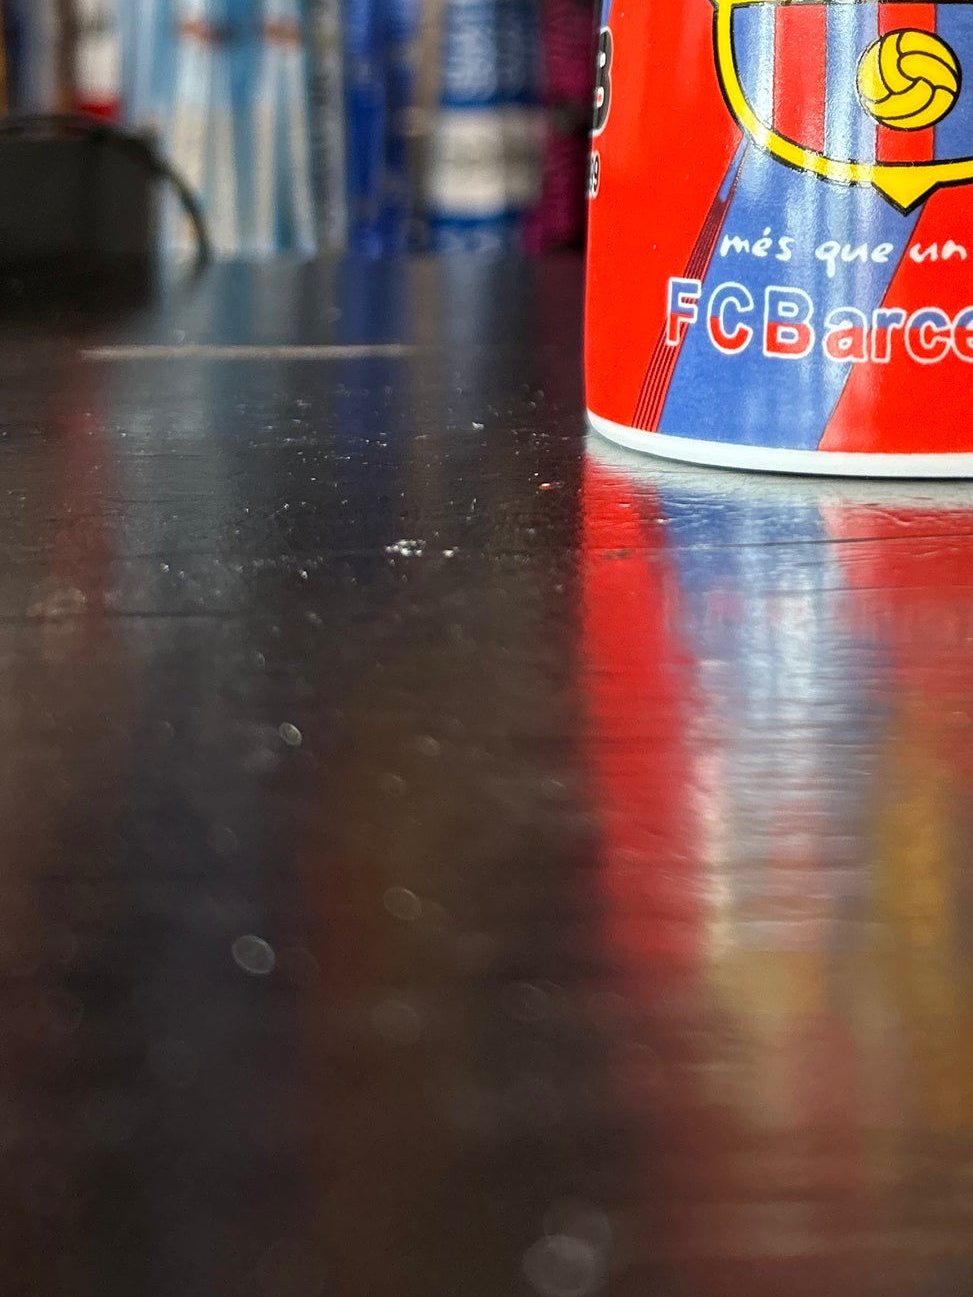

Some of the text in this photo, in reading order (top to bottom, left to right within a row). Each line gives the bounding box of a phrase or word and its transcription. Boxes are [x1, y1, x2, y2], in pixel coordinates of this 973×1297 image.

[720, 227, 795, 262] més
[814, 240, 894, 278] que
[909, 240, 968, 263] un
